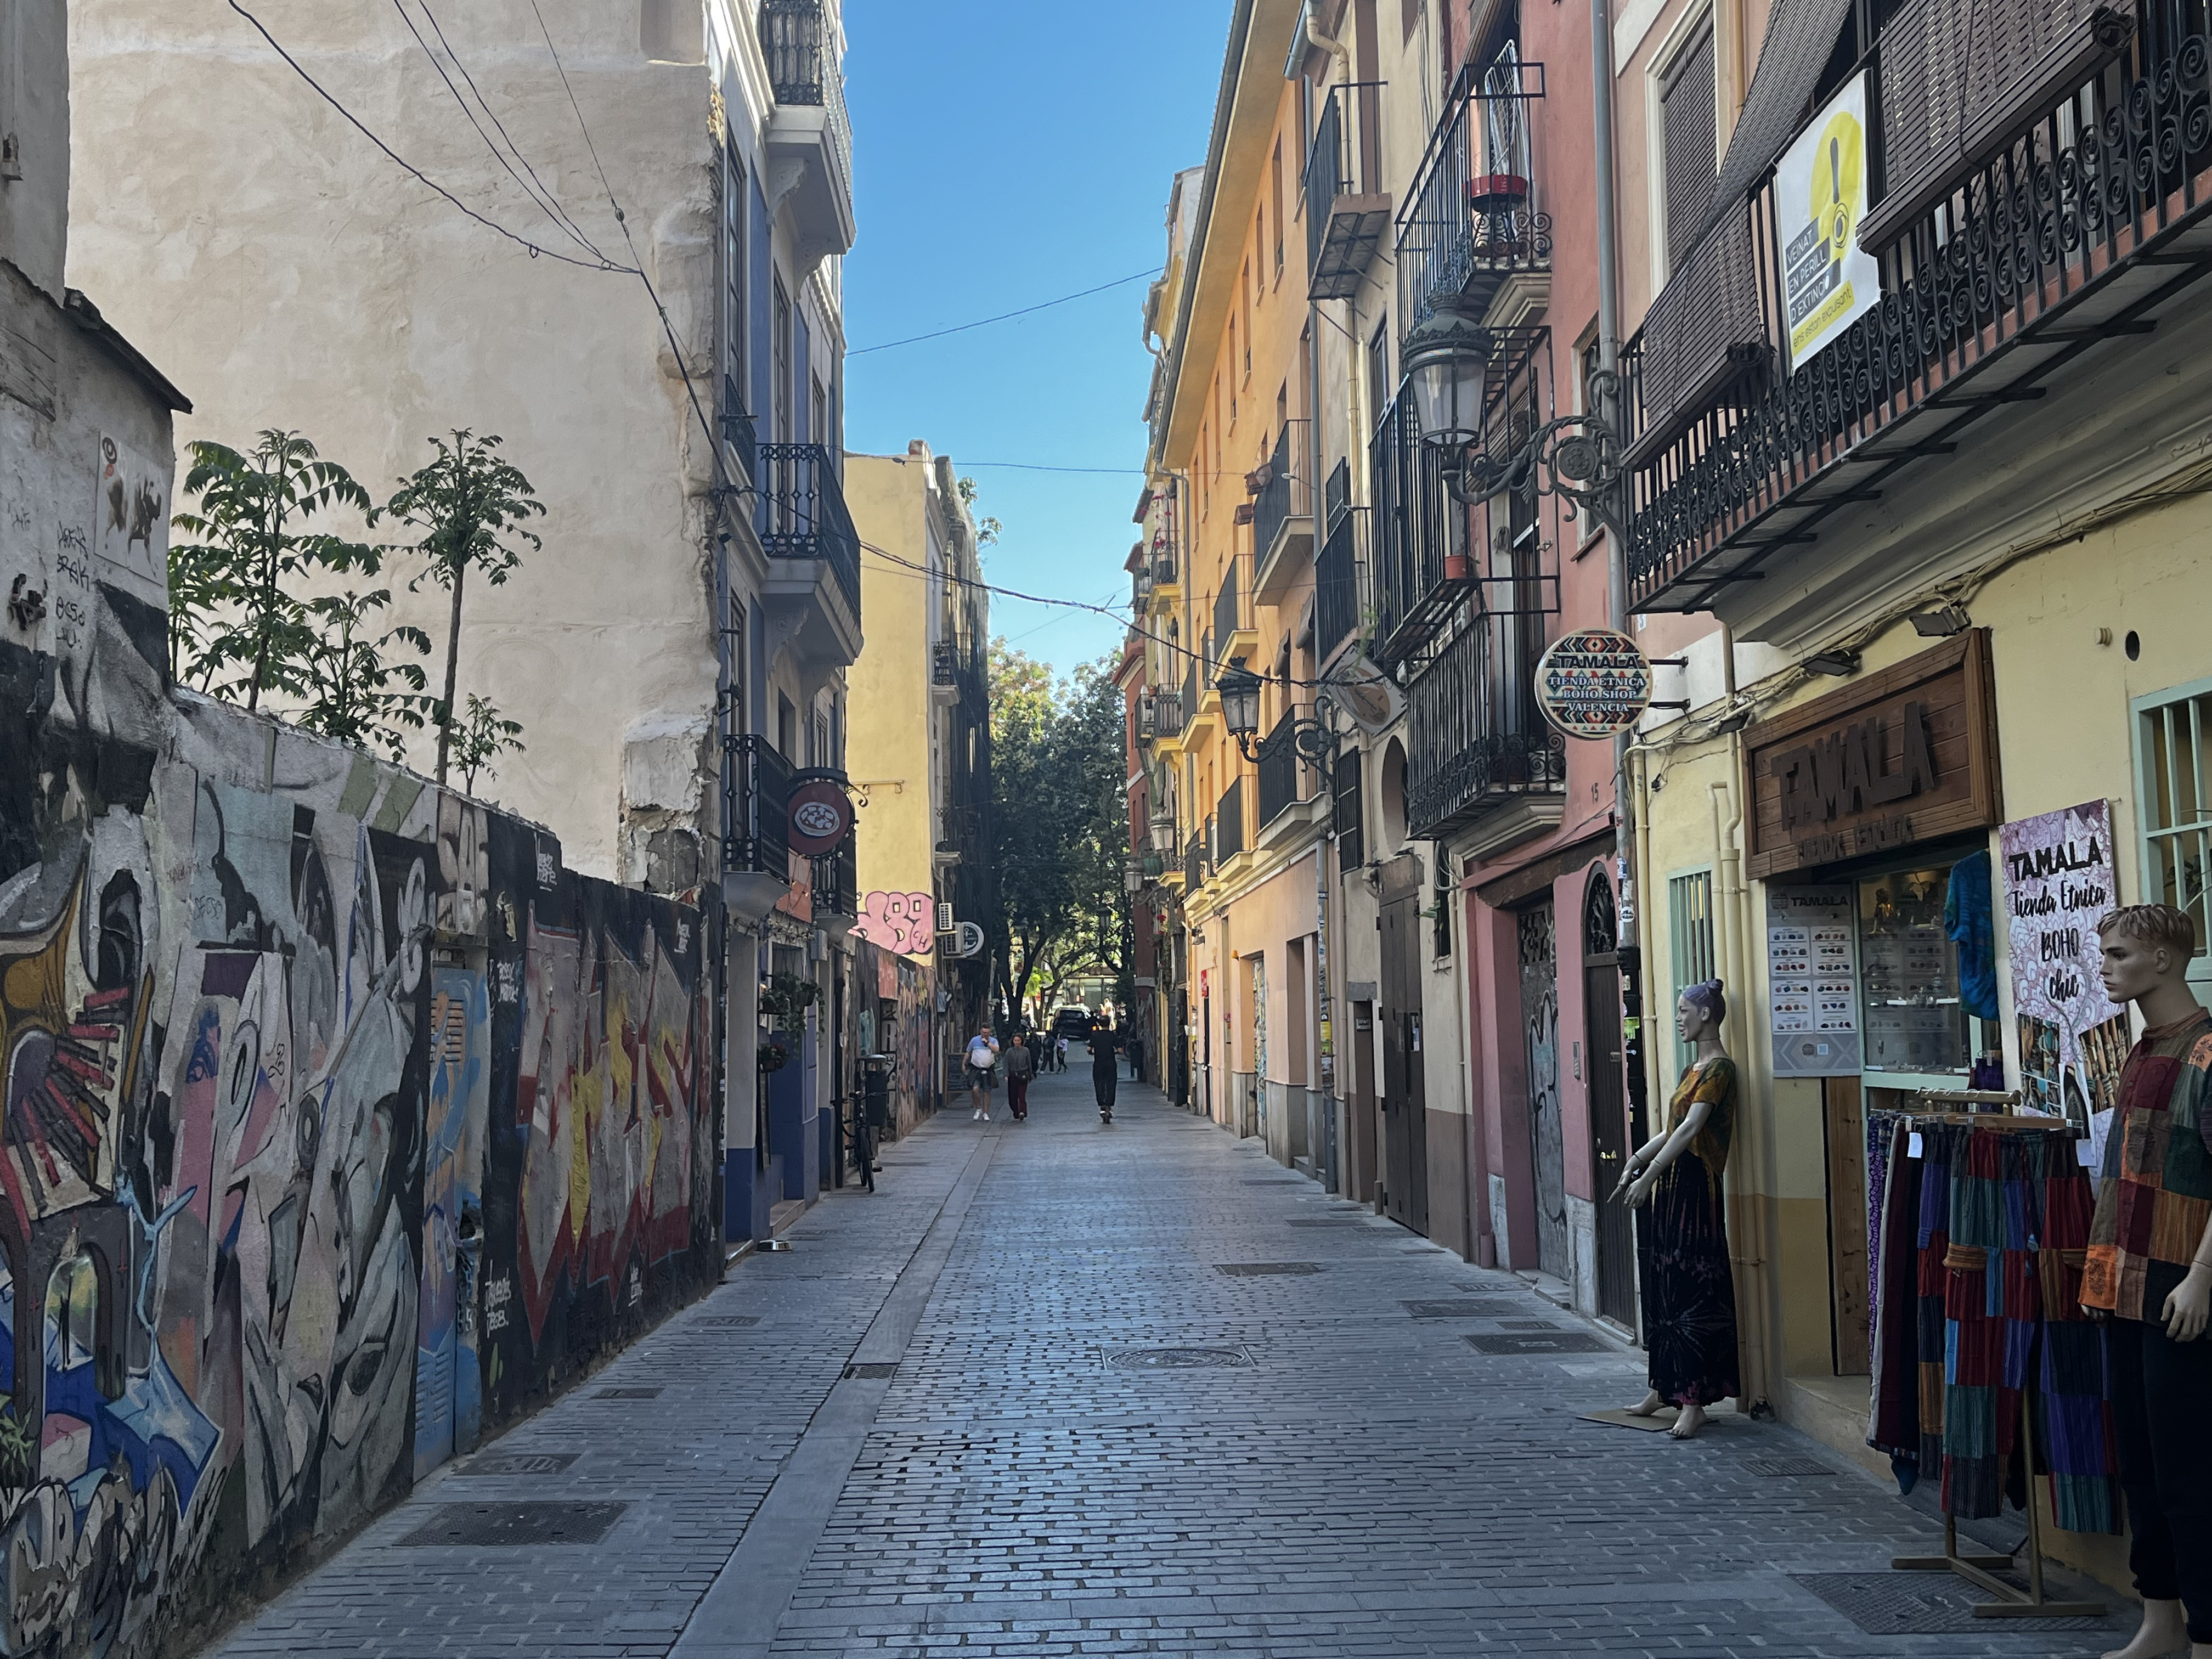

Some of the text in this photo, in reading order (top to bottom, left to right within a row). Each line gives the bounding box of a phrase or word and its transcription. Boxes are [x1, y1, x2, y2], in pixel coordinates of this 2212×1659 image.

[1787, 229, 1813, 264] VEÏNAT
[1788, 249, 1827, 295] EN PERILL
[1791, 270, 1830, 322] D'EXTINCIÓ
[1821, 288, 1852, 321] expulsant
[1556, 654, 1639, 669] TAMALA
[1548, 677, 1645, 686] TIENDA ETNICA
[1563, 690, 1637, 699] BOHO SHOP
[1567, 703, 1629, 712] VALENCIA
[1771, 701, 1935, 832] TAMALA
[2009, 836, 2103, 882] TAMALA
[1791, 896, 1848, 907] TAMALA
[2012, 885, 2057, 918] Tienda
[2041, 927, 2079, 962] BOHO
[2049, 968, 2079, 1002] chic
